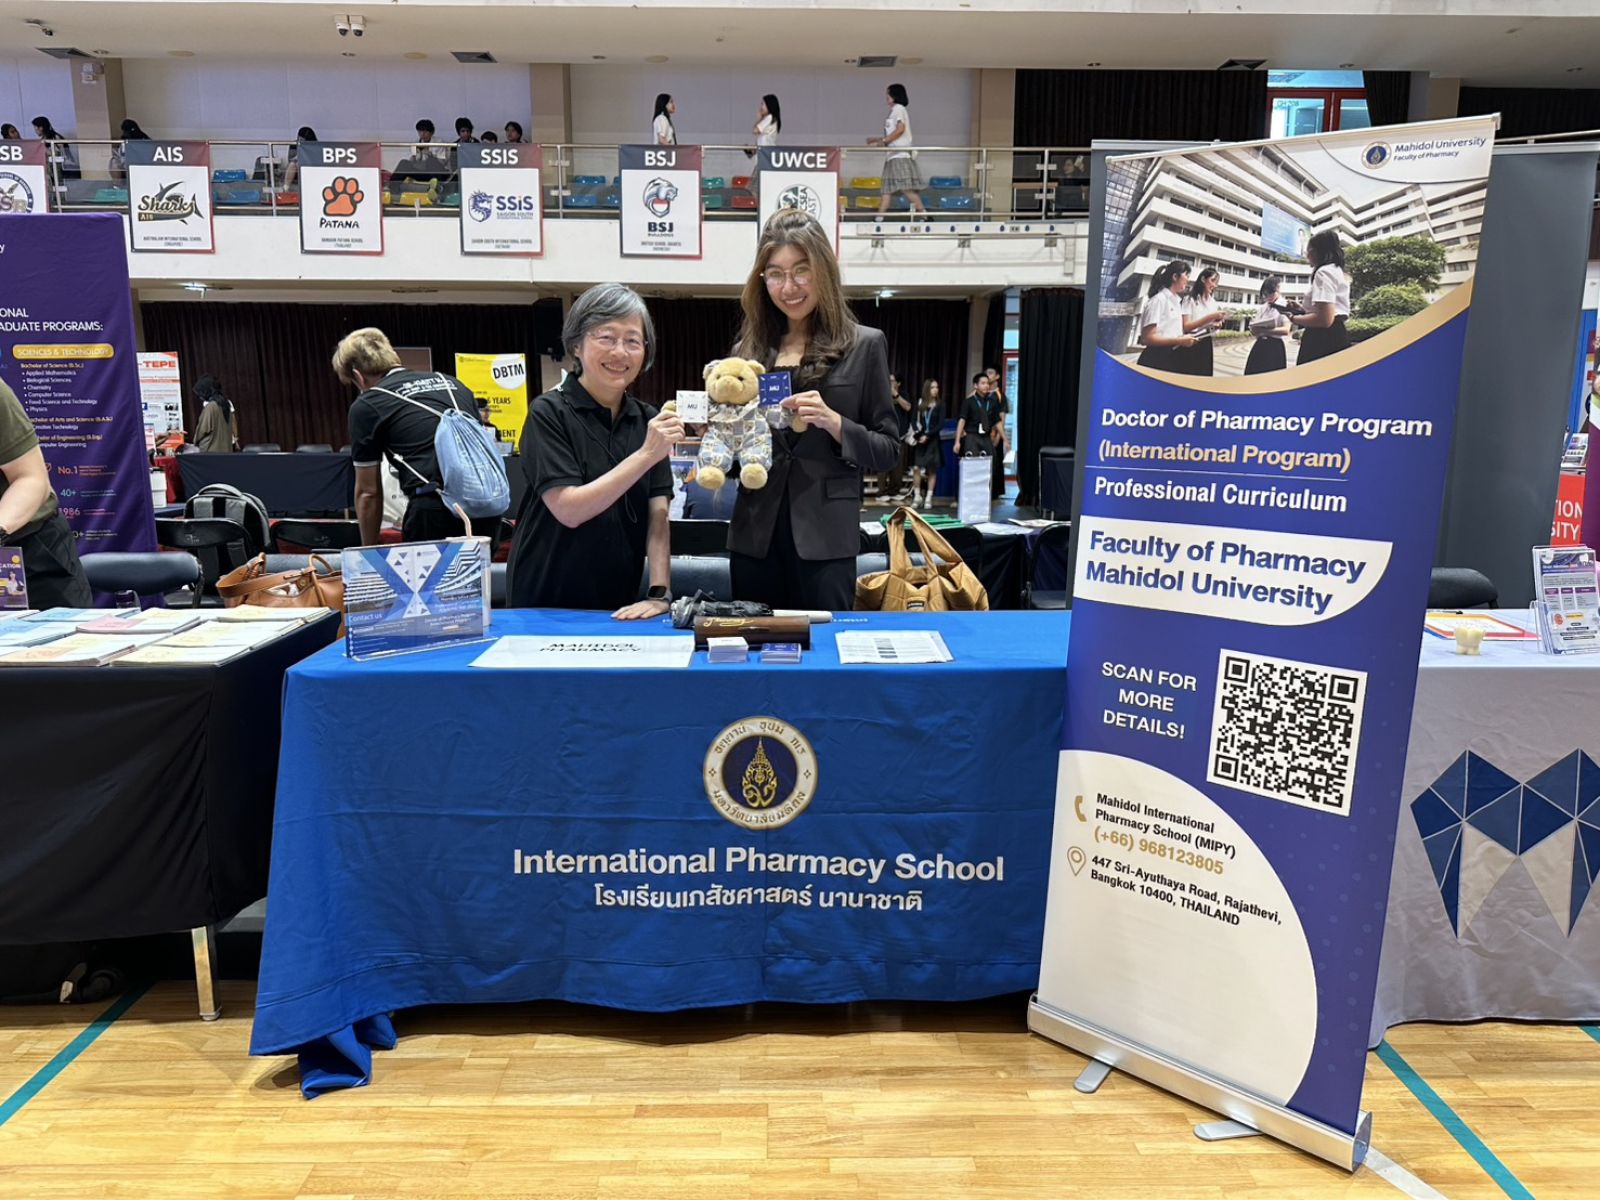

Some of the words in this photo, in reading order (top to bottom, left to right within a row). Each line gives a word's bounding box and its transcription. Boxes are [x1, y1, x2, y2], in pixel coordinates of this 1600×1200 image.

[153, 146, 184, 162] AIS
[322, 148, 357, 164] BPS
[480, 148, 518, 164] SSIS
[1395, 142, 1434, 152] Mahidol
[1436, 136, 1486, 148] University
[644, 151, 676, 167] BSJ
[771, 152, 827, 168] UWCE
[648, 222, 674, 232] BSJ
[43, 322, 104, 331] PROGRAMS:
[493, 364, 524, 379] DBTM
[1102, 408, 1168, 427] Doctor
[1174, 410, 1196, 428] of
[1200, 410, 1315, 436] Pharmacy
[1321, 412, 1432, 439] Program
[58, 466, 78, 474] No.1
[1099, 439, 1237, 462] (International
[1242, 445, 1351, 474] Program)
[1095, 476, 1216, 502] Professional
[1223, 484, 1347, 512] Curriculum
[1556, 500, 1582, 518] ION
[1090, 530, 1180, 562] Faculty
[1187, 541, 1214, 562] of
[1220, 542, 1366, 584] Pharmacy
[1086, 560, 1184, 590] Mahidol
[1192, 572, 1332, 615] University
[1102, 662, 1152, 684] SCAN
[1158, 671, 1196, 691] FOR
[1119, 688, 1174, 712] MORE
[1104, 710, 1184, 739] DETAILS!
[1096, 793, 1140, 813] Mahidol
[1144, 805, 1214, 833] International
[1096, 808, 1150, 834] Pharmacy
[1154, 824, 1192, 844] School
[1195, 835, 1236, 859] (MIPY)
[1094, 826, 1134, 852] (+66)
[1140, 838, 1224, 875] 968123805
[514, 848, 716, 874] International
[726, 848, 886, 884] Pharmacy
[895, 853, 1004, 880] School
[595, 884, 812, 908] โรงเรียนเภสัชศาสตร์
[819, 890, 922, 910] นานาชาติ
[1091, 869, 1136, 892] Bangkok
[1140, 885, 1176, 906] 10400,
[1180, 896, 1240, 926] THAILAND
[1092, 855, 1112, 868] 447
[1114, 862, 1185, 892] Sri-Ayuthaya
[1189, 884, 1220, 904] Road,
[1224, 895, 1282, 925] Rajathevi,
